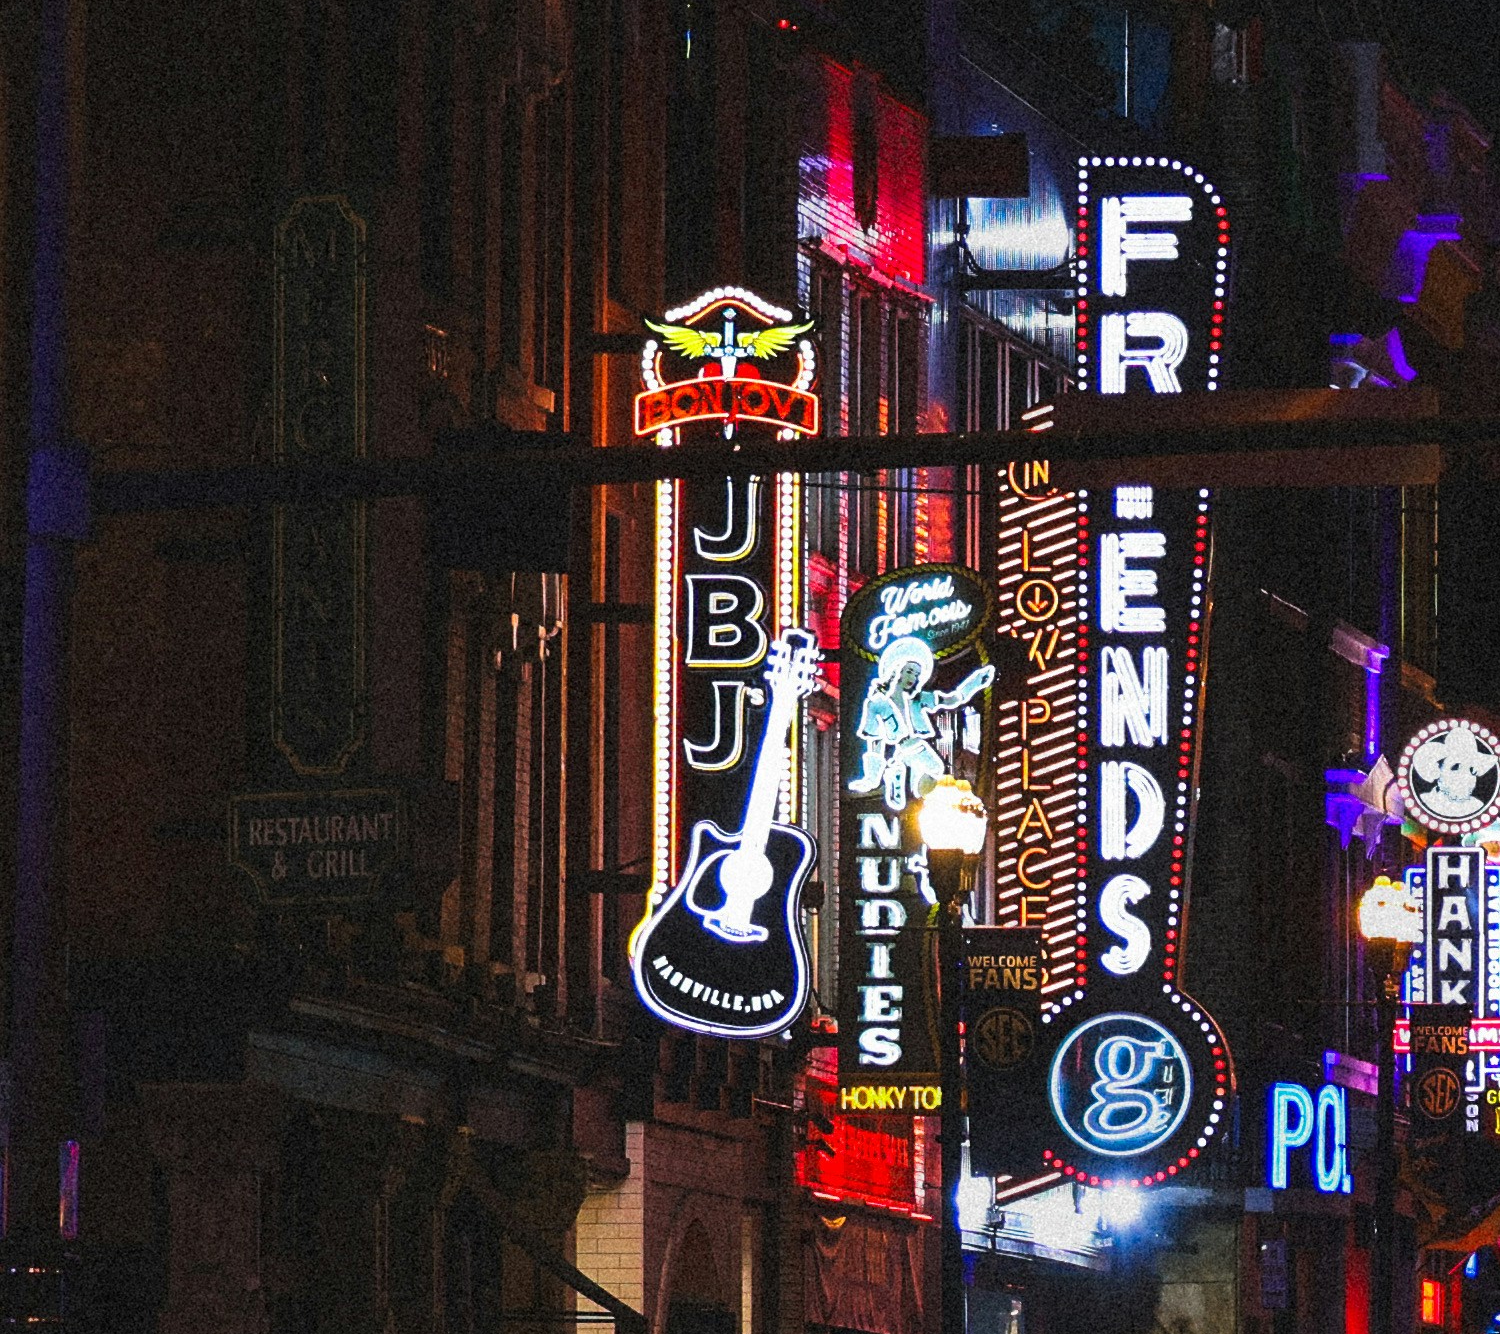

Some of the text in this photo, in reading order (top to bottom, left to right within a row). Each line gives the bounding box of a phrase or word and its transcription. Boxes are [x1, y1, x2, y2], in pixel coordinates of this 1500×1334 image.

[880, 575, 955, 614] World
[868, 599, 972, 650] Famous
[250, 812, 395, 846] RESTAURANT
[1017, 697, 1055, 929] PLACE
[308, 849, 369, 879] GRILL
[1437, 855, 1473, 1005] HANK
[967, 955, 1037, 968] WELCOME
[968, 968, 1038, 990] FANS
[1414, 1025, 1469, 1036] WELCOME
[1414, 1037, 1469, 1055] FANS
[841, 1085, 907, 1110] HONKY
[1423, 1074, 1457, 1114] SEC
[1271, 1082, 1352, 1194] PO
